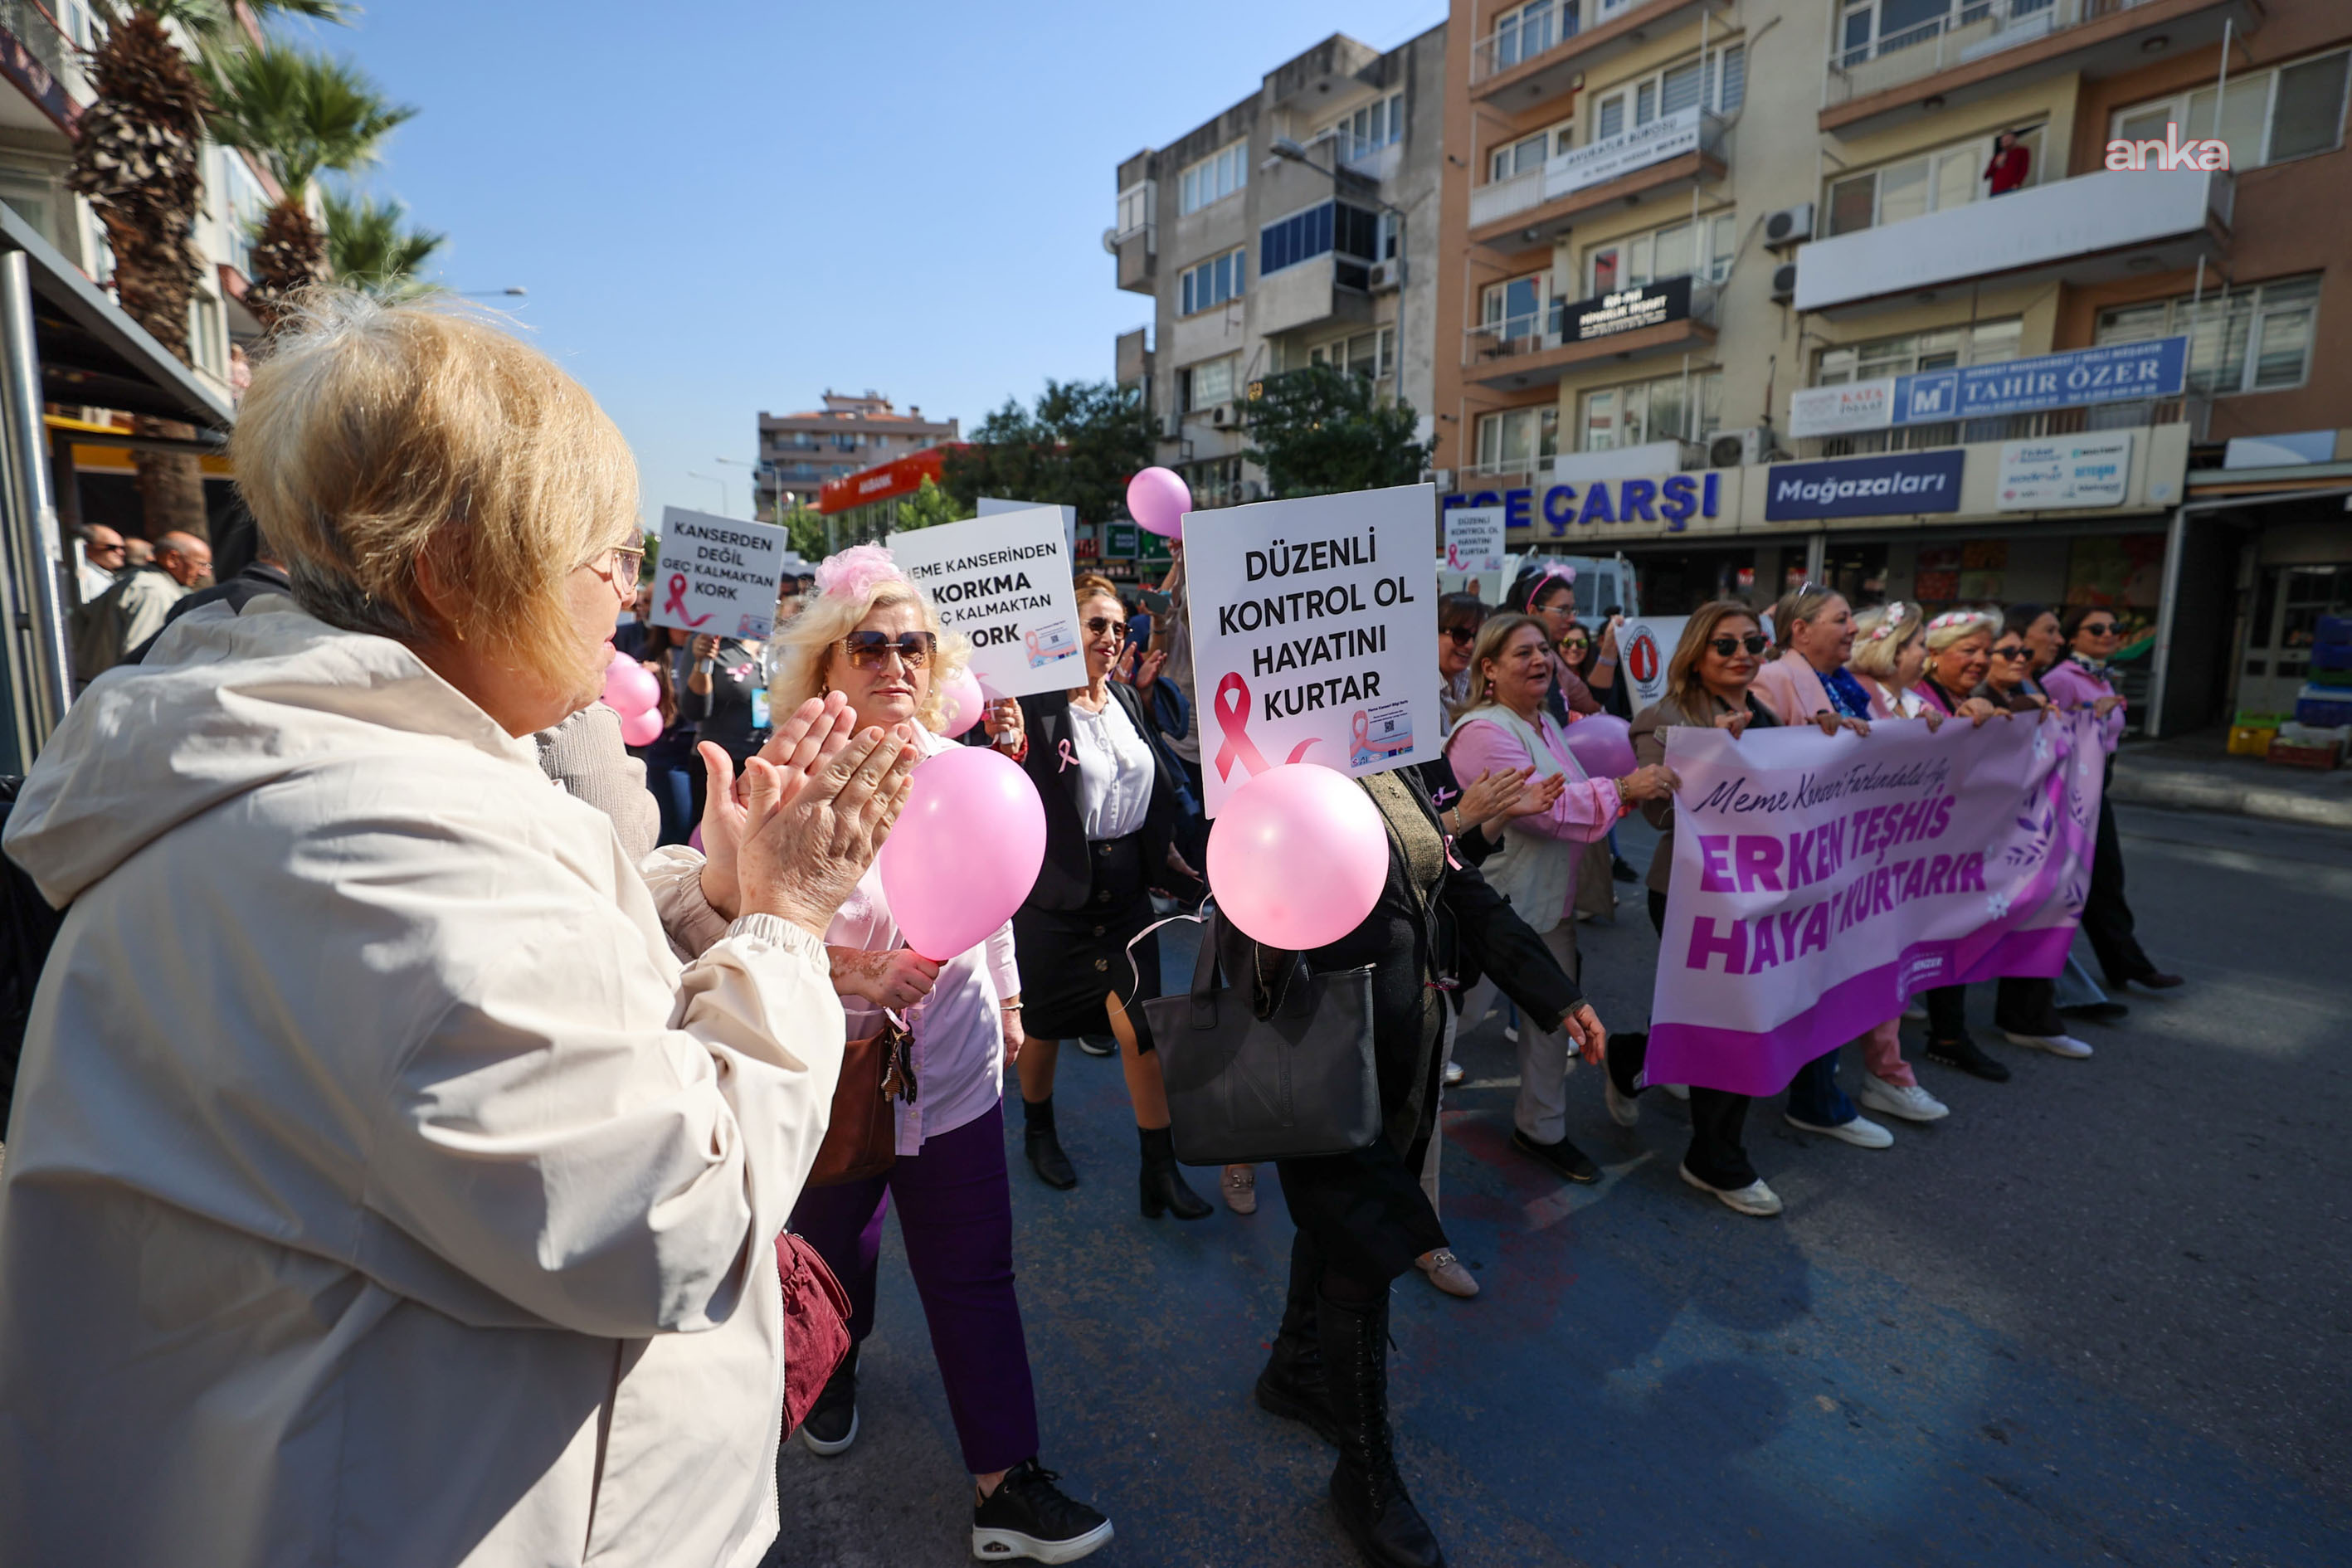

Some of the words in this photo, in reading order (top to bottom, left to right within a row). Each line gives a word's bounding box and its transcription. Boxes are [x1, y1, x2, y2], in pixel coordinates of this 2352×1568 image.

[1964, 372, 2057, 402] TAHİR
[2066, 359, 2160, 390] ÖZER
[1543, 473, 1722, 537] ÇARŞI
[1776, 471, 1946, 504] Mağazaları
[674, 522, 773, 552] KANSERDEN
[1245, 526, 1376, 582] DÜZENLİ
[697, 545, 744, 567] DEĞİL
[946, 542, 1058, 572] KANSERİNDEN
[694, 563, 774, 587] KALMAKTAN
[694, 582, 738, 601] KORK
[932, 572, 1032, 605] KORKMA
[956, 594, 1052, 621] KALMAKTAN
[1219, 584, 1366, 635] KONTROL
[1374, 576, 1415, 607] OL
[966, 623, 1021, 648] ORK
[1253, 625, 1386, 678] HAYATINI
[1264, 671, 1381, 721] KURTAR
[1692, 777, 1790, 815] Meme
[1697, 816, 1848, 894] ERKEN
[1849, 783, 1956, 866] TEŞHİS
[1685, 890, 1843, 976] HAYAT
[1837, 850, 1987, 933] KURTARIR
